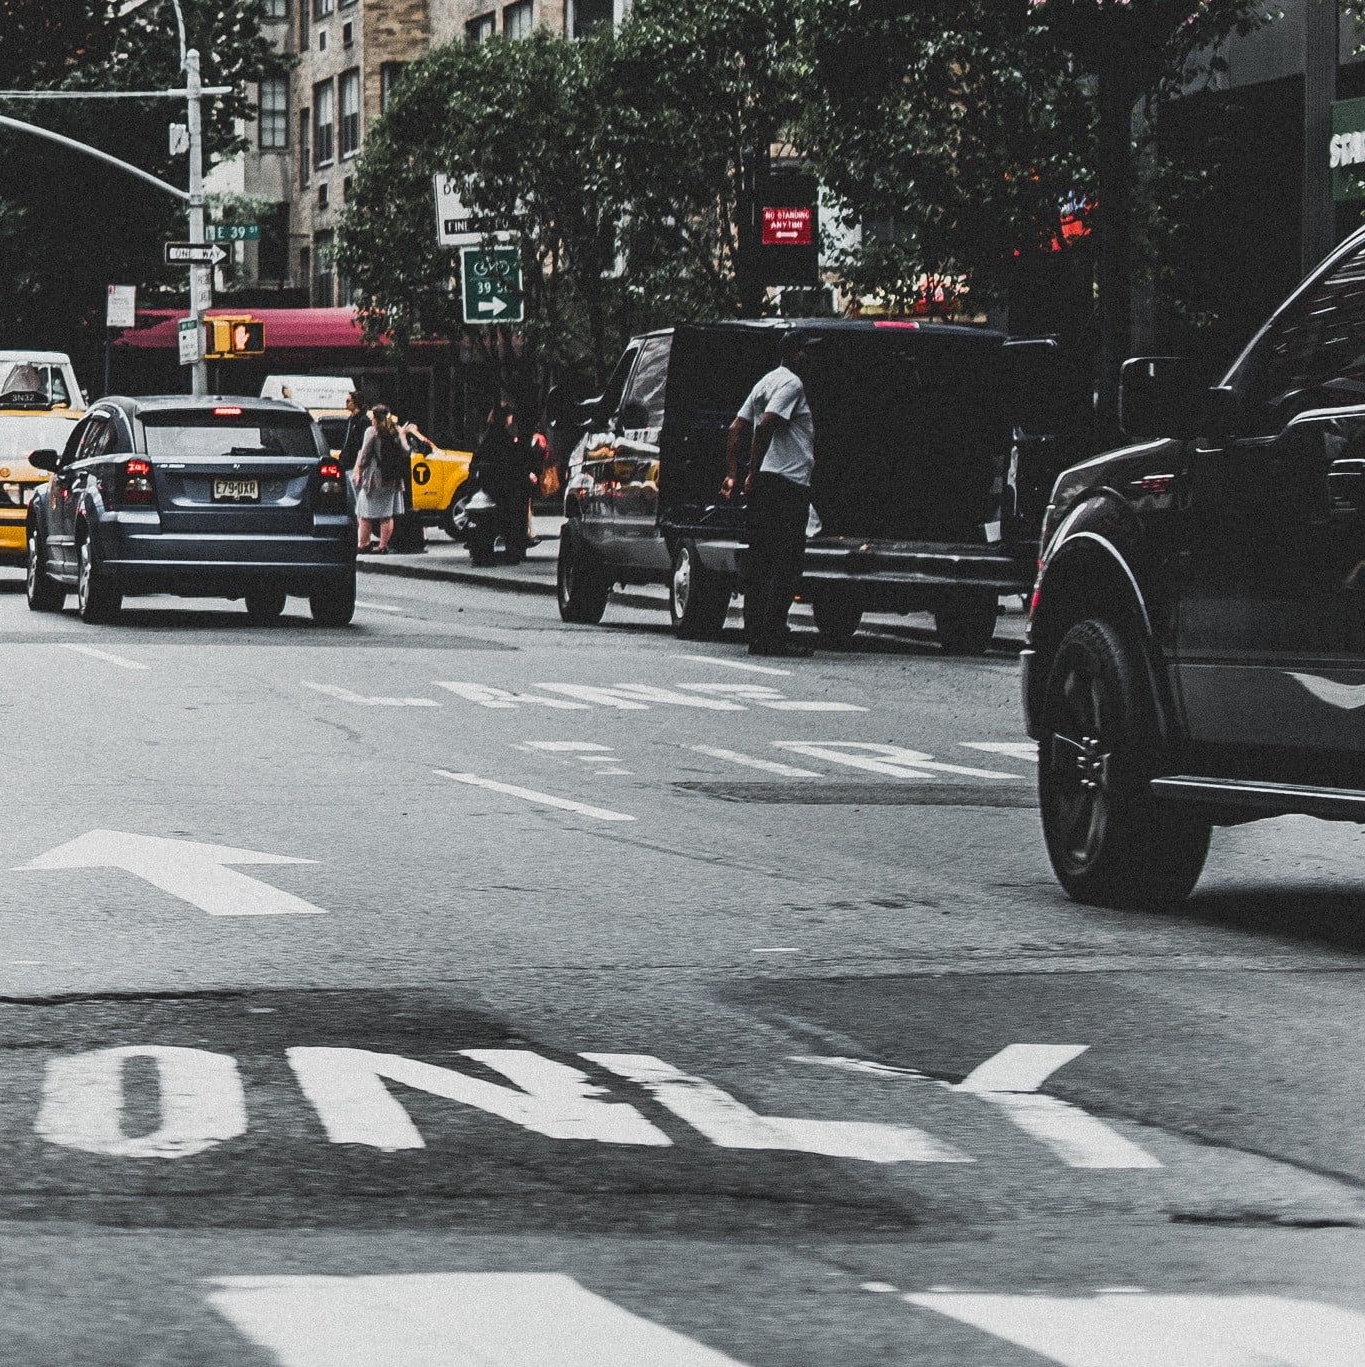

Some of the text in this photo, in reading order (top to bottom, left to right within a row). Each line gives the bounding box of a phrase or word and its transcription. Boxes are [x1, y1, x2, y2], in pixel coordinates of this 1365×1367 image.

[765, 209, 810, 220] NO STANDING
[770, 221, 803, 230] ANYTIME
[218, 226, 225, 239] E
[230, 226, 246, 239] 39
[477, 282, 491, 294] 39
[34, 1043, 1166, 1170] ONLY
